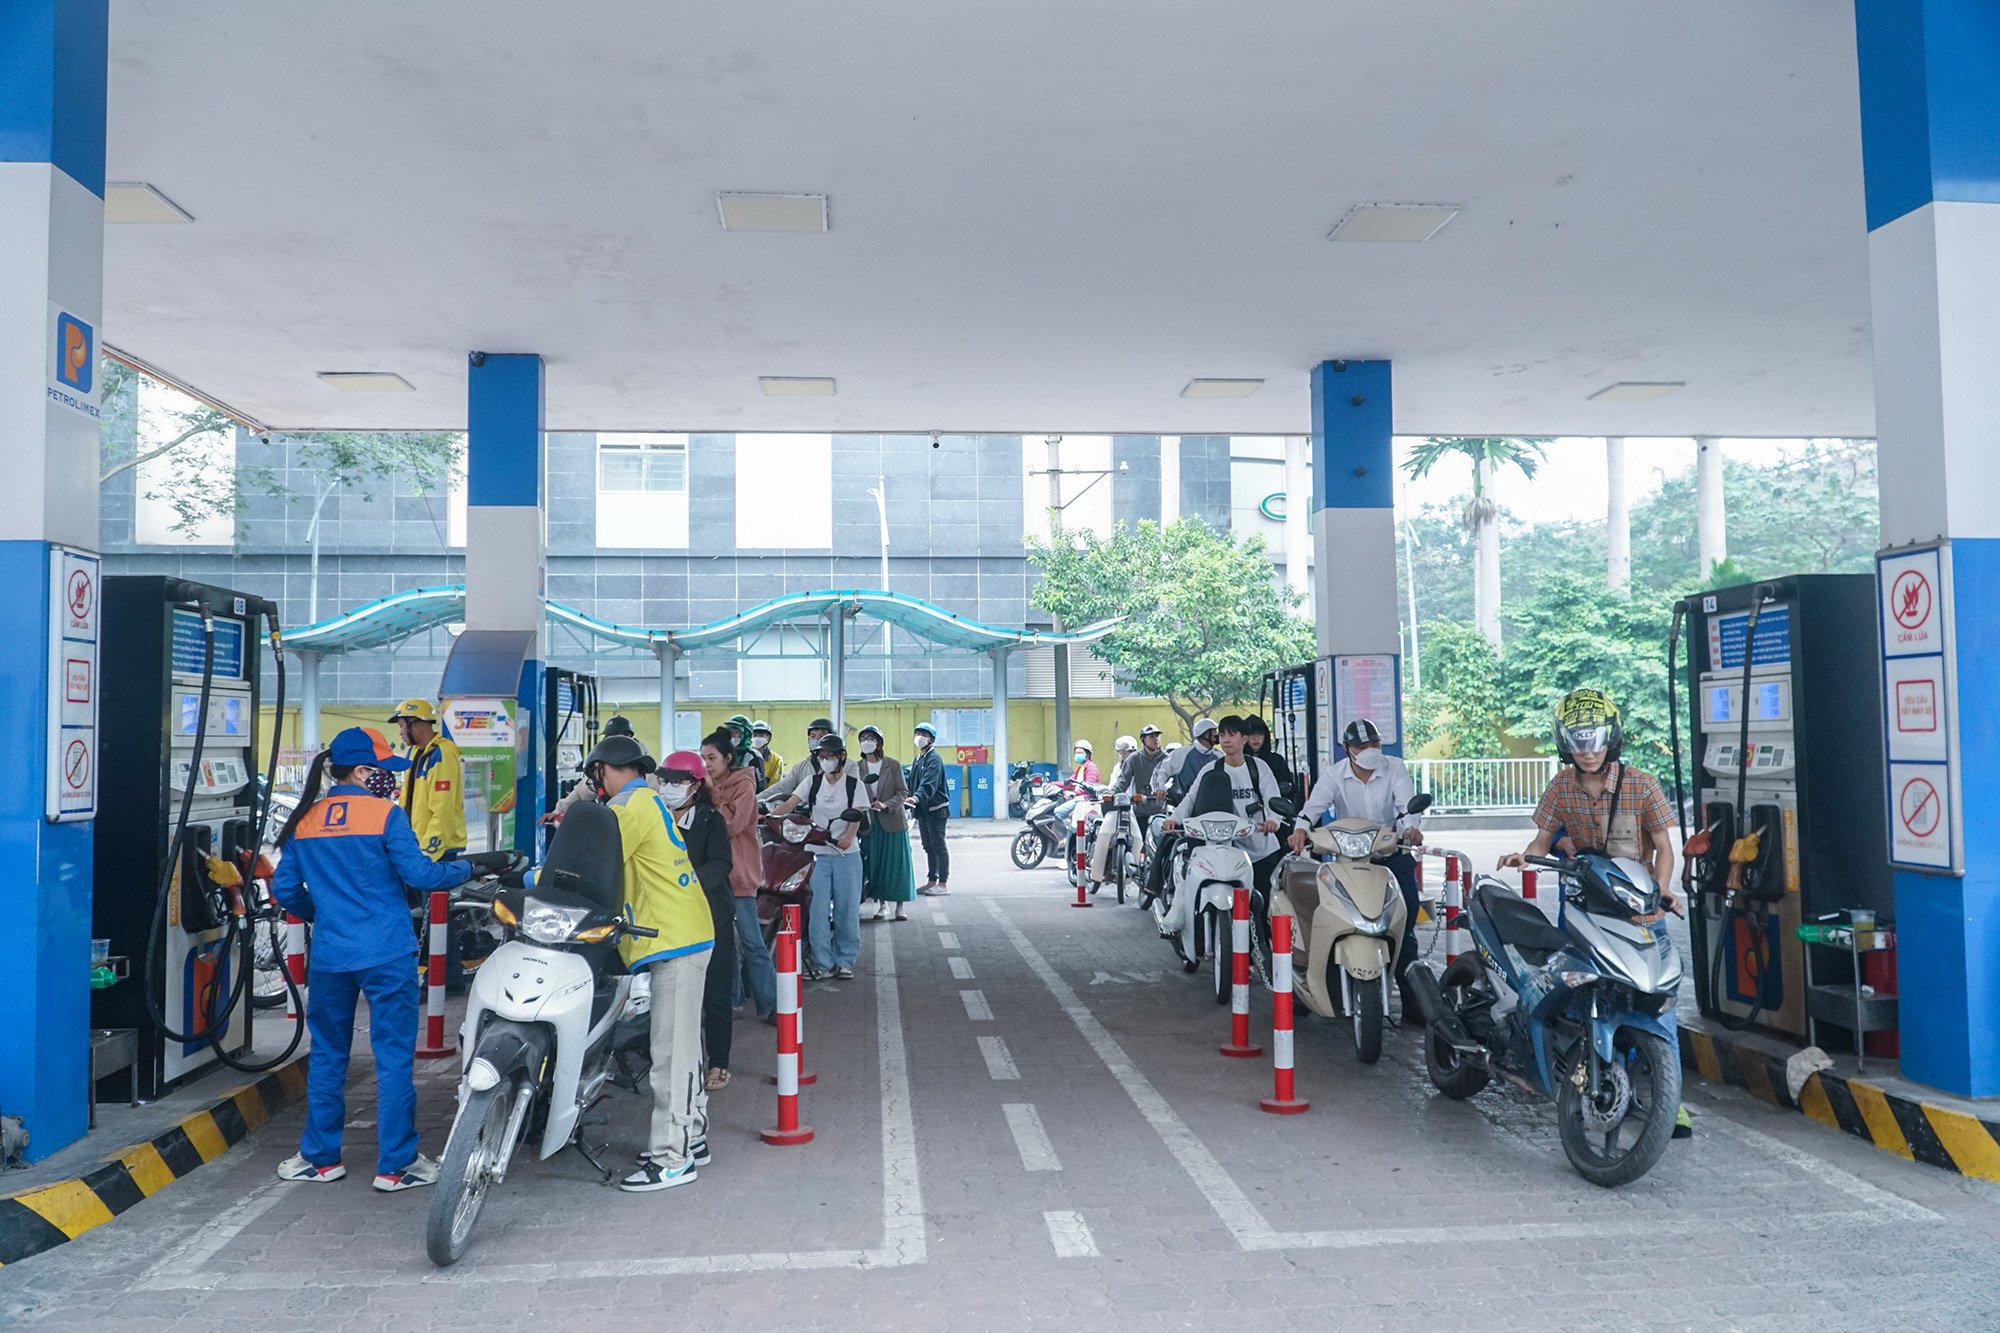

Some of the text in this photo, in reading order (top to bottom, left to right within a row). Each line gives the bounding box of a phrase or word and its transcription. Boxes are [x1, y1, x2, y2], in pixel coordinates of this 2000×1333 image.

[47, 387, 100, 418] PETROLIMEX
[1706, 598, 1715, 610] 14
[522, 956, 548, 967] HONDA
